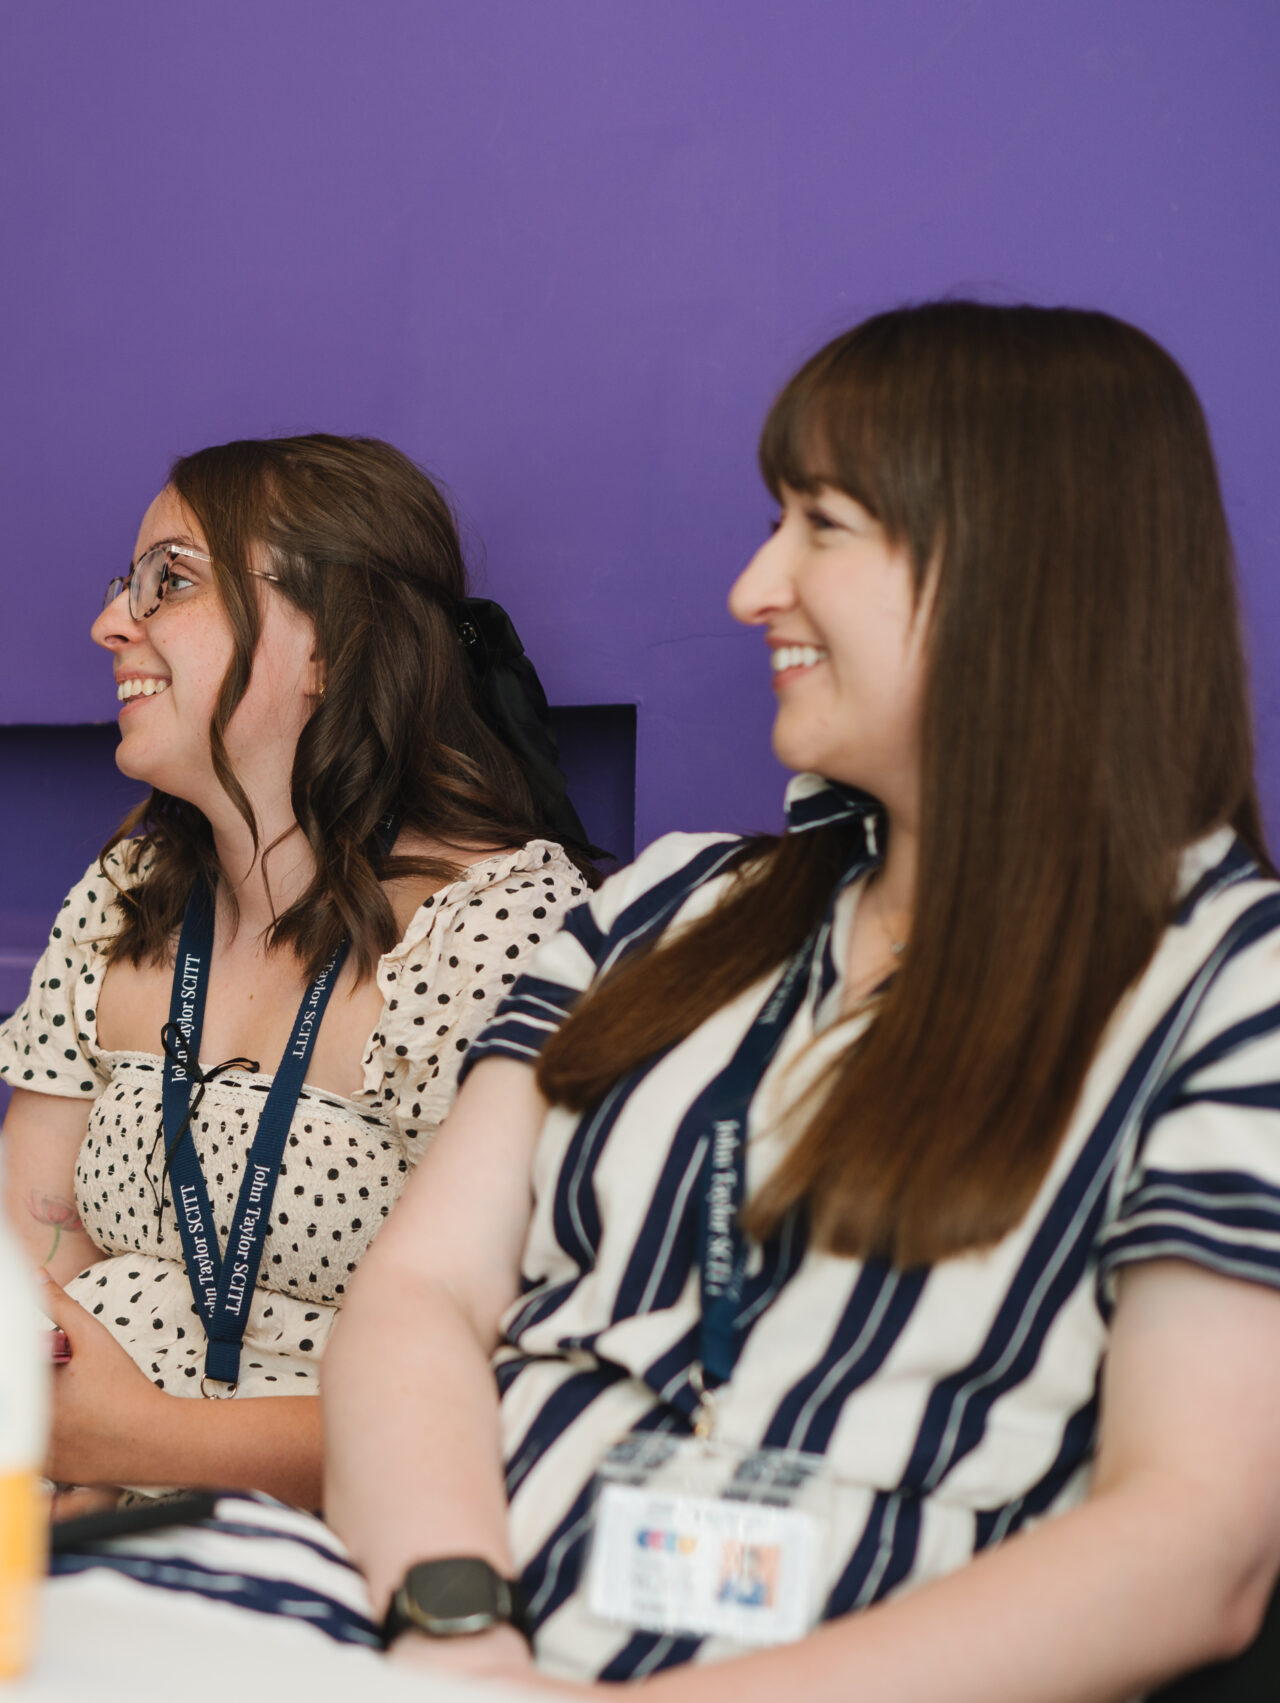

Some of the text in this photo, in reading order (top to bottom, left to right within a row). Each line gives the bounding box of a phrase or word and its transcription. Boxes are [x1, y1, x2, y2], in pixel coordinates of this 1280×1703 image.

[181, 954, 201, 999] SCITT
[292, 960, 336, 1059] Taylor SCITT
[712, 1119, 741, 1168] John
[180, 1184, 204, 1234] SCITT
[705, 1168, 738, 1235] Taylor
[193, 1236, 215, 1286] Taylor
[225, 1164, 270, 1316] John Taylor SCITT
